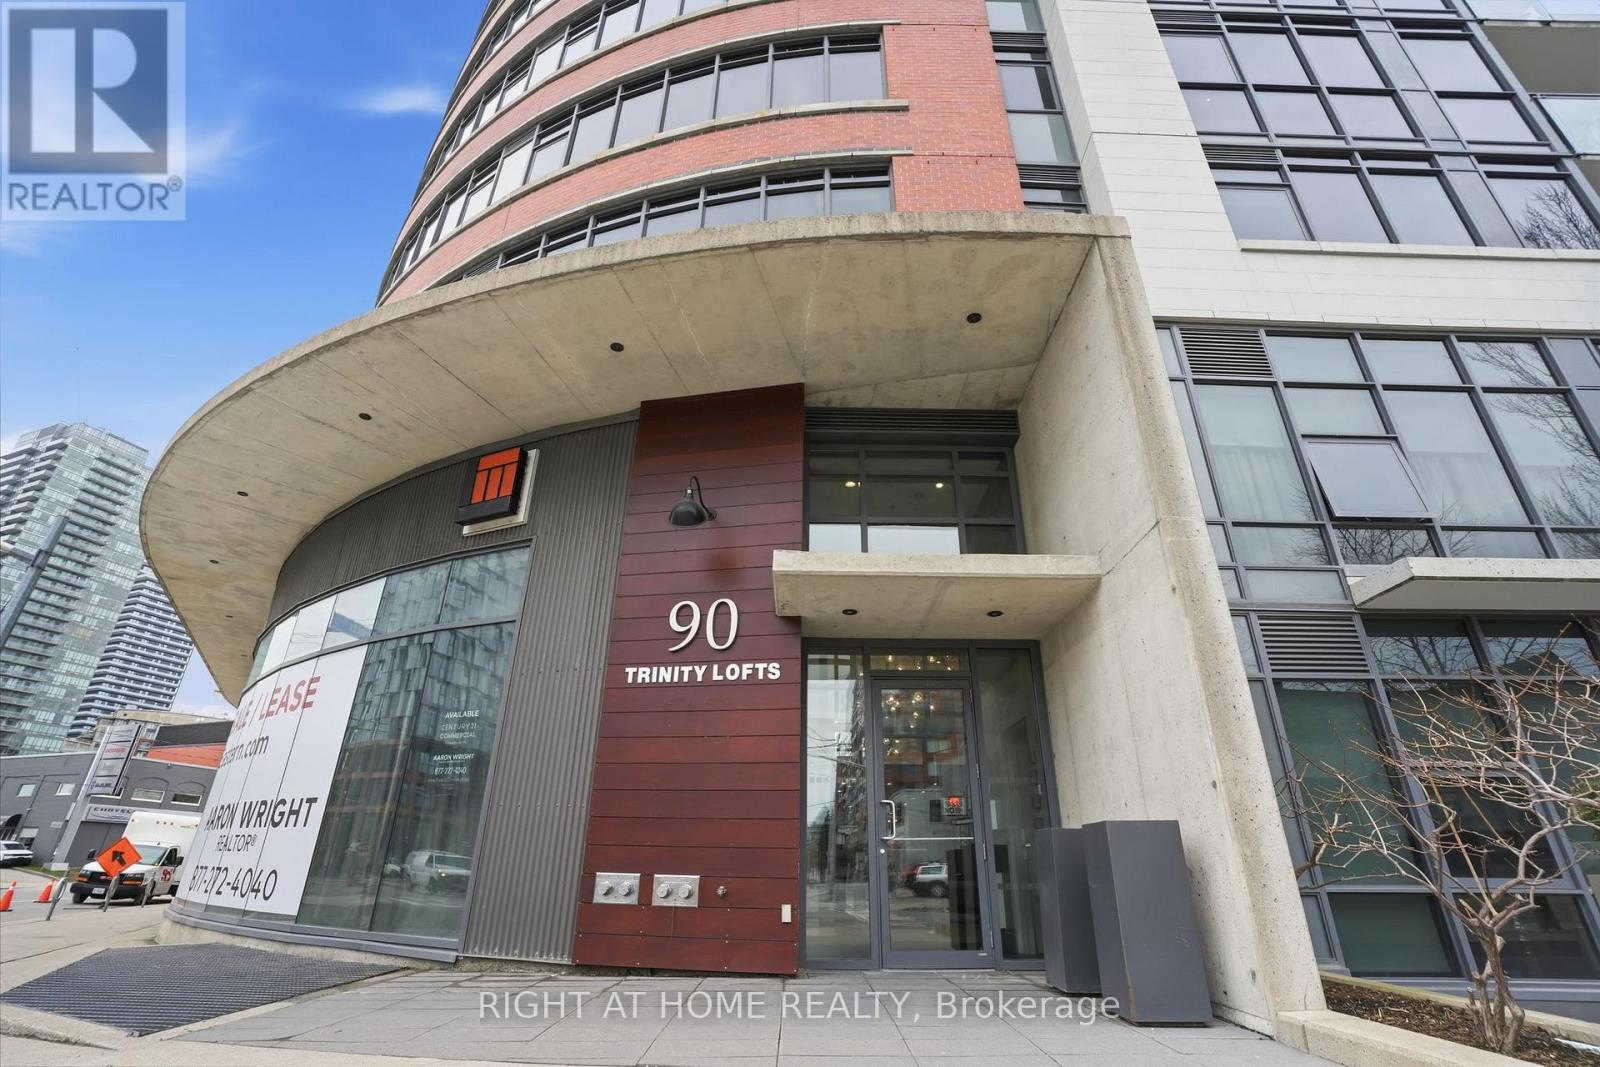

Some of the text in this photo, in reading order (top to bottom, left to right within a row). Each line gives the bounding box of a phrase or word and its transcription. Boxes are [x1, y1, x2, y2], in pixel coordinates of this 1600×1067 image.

[668, 598, 738, 651] 90
[625, 662, 781, 684] TRINITY LOFTS
[259, 676, 320, 721] LEASE
[445, 709, 480, 718] AVAILABLE
[240, 797, 318, 829] WRIGHT
